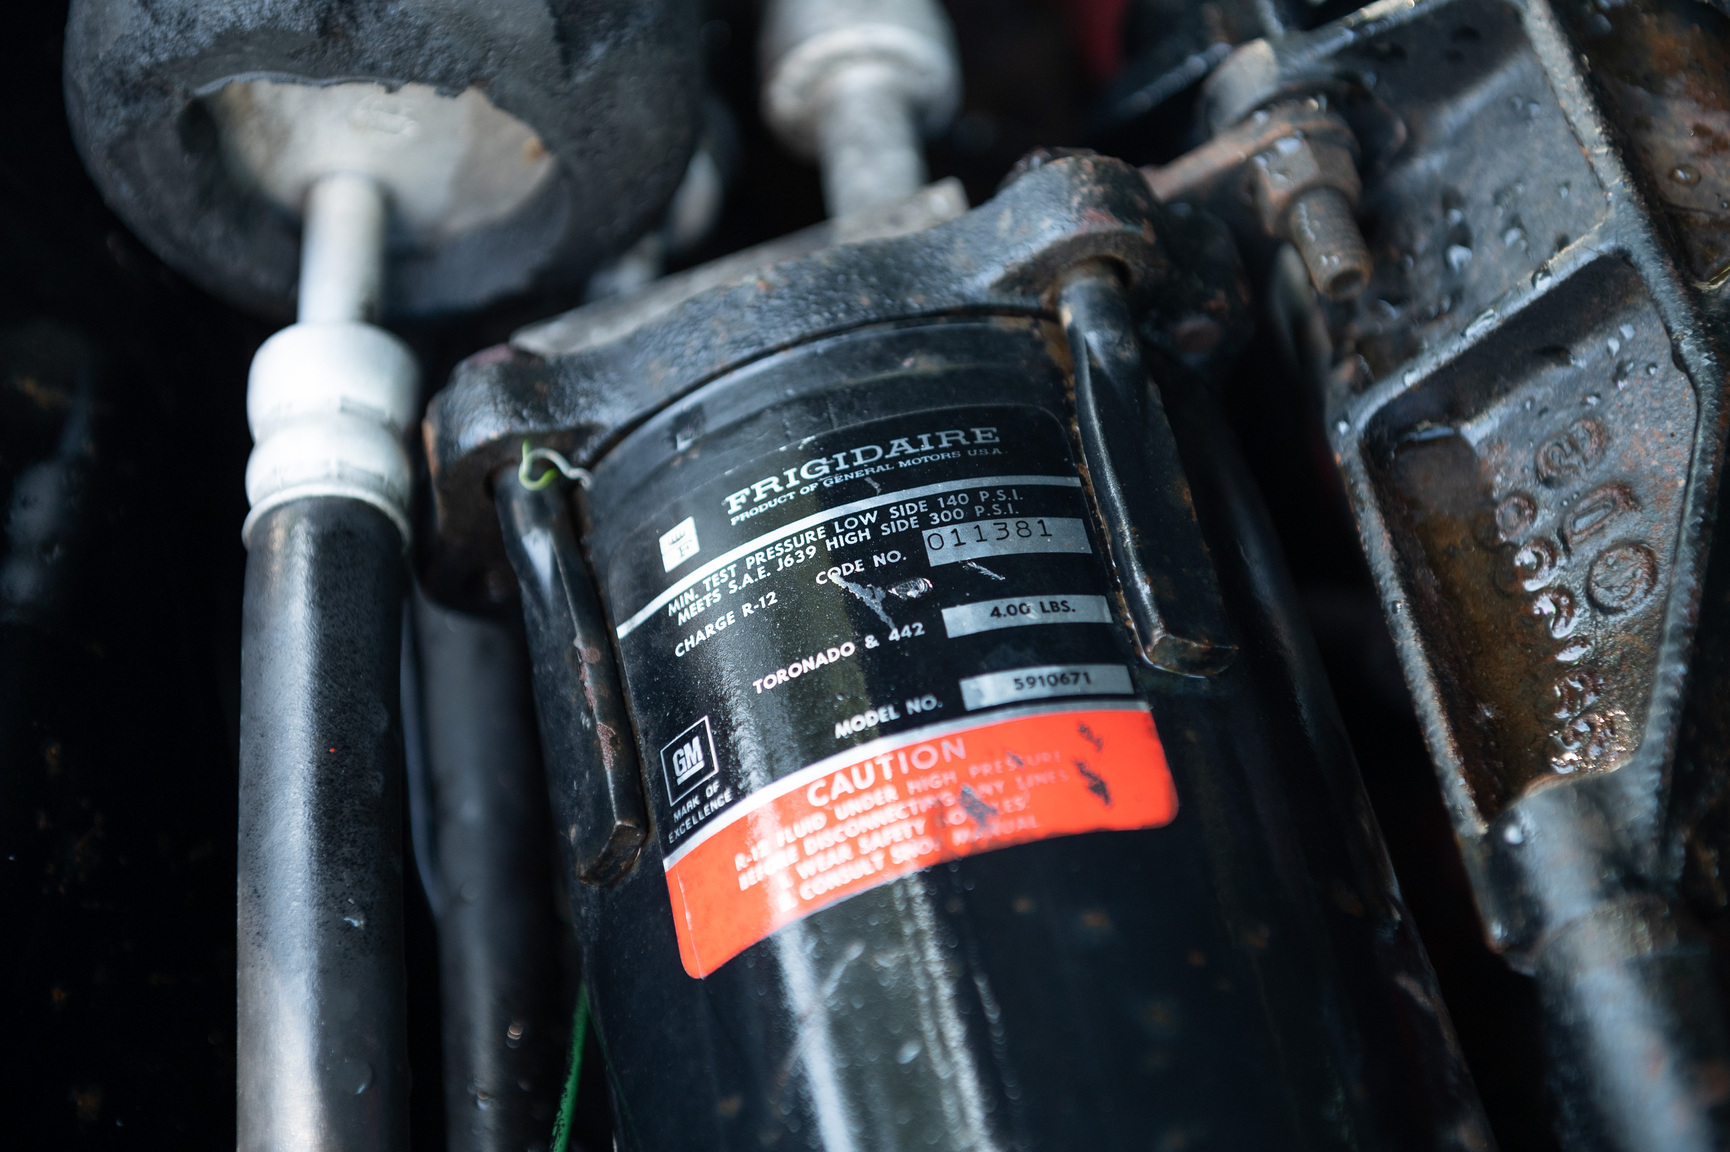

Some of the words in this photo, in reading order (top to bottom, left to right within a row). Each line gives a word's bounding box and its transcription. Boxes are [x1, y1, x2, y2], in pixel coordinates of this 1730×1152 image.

[725, 427, 1000, 514] FRIGIDAIRE
[731, 491, 796, 526] PRODUCT
[800, 482, 818, 495] OF
[823, 464, 894, 488] GENERAL
[899, 451, 961, 468] MOTORS
[668, 589, 699, 616] MIN.
[703, 564, 737, 592] TEST
[745, 527, 827, 570] PRESSURE
[834, 510, 878, 534] LOW
[889, 500, 928, 519] SIDE
[938, 494, 969, 508] 140
[979, 489, 1023, 502] P.S.I.
[677, 588, 722, 626] MEETS
[728, 566, 771, 594] S.A.E.
[777, 545, 817, 572] J639
[825, 528, 871, 551] HIGH
[880, 517, 919, 537] SIDE
[929, 508, 964, 525] 300
[975, 503, 1019, 517] P.S.I.
[815, 559, 865, 585] CODE
[873, 550, 907, 568] NO.
[927, 519, 1053, 551] 011381
[675, 611, 736, 658] CHARGE
[742, 591, 778, 618] R-12
[752, 641, 856, 695] TORONADO
[864, 635, 880, 649] &
[888, 622, 926, 642] 442
[990, 603, 1031, 618] 4.00
[1039, 600, 1077, 614] LBS.
[835, 704, 900, 739] MODEL
[905, 694, 943, 716] NO.
[1013, 672, 1092, 691] 5910671
[672, 736, 704, 778] GM
[807, 737, 967, 807] CAUTION
[668, 787, 734, 844] EXCELLENCE
[673, 795, 701, 823] MARK
[705, 779, 720, 798] OF
[776, 811, 828, 848] FLUID
[834, 783, 899, 820] UNDER
[906, 770, 958, 795] HIGH
[968, 750, 1063, 778] PRESURE
[803, 789, 956, 856] DISCONNECTING
[966, 780, 1005, 799] NY
[795, 842, 854, 880] WEAR
[857, 817, 926, 855] SAFETY
[799, 850, 885, 901] CONSULT
